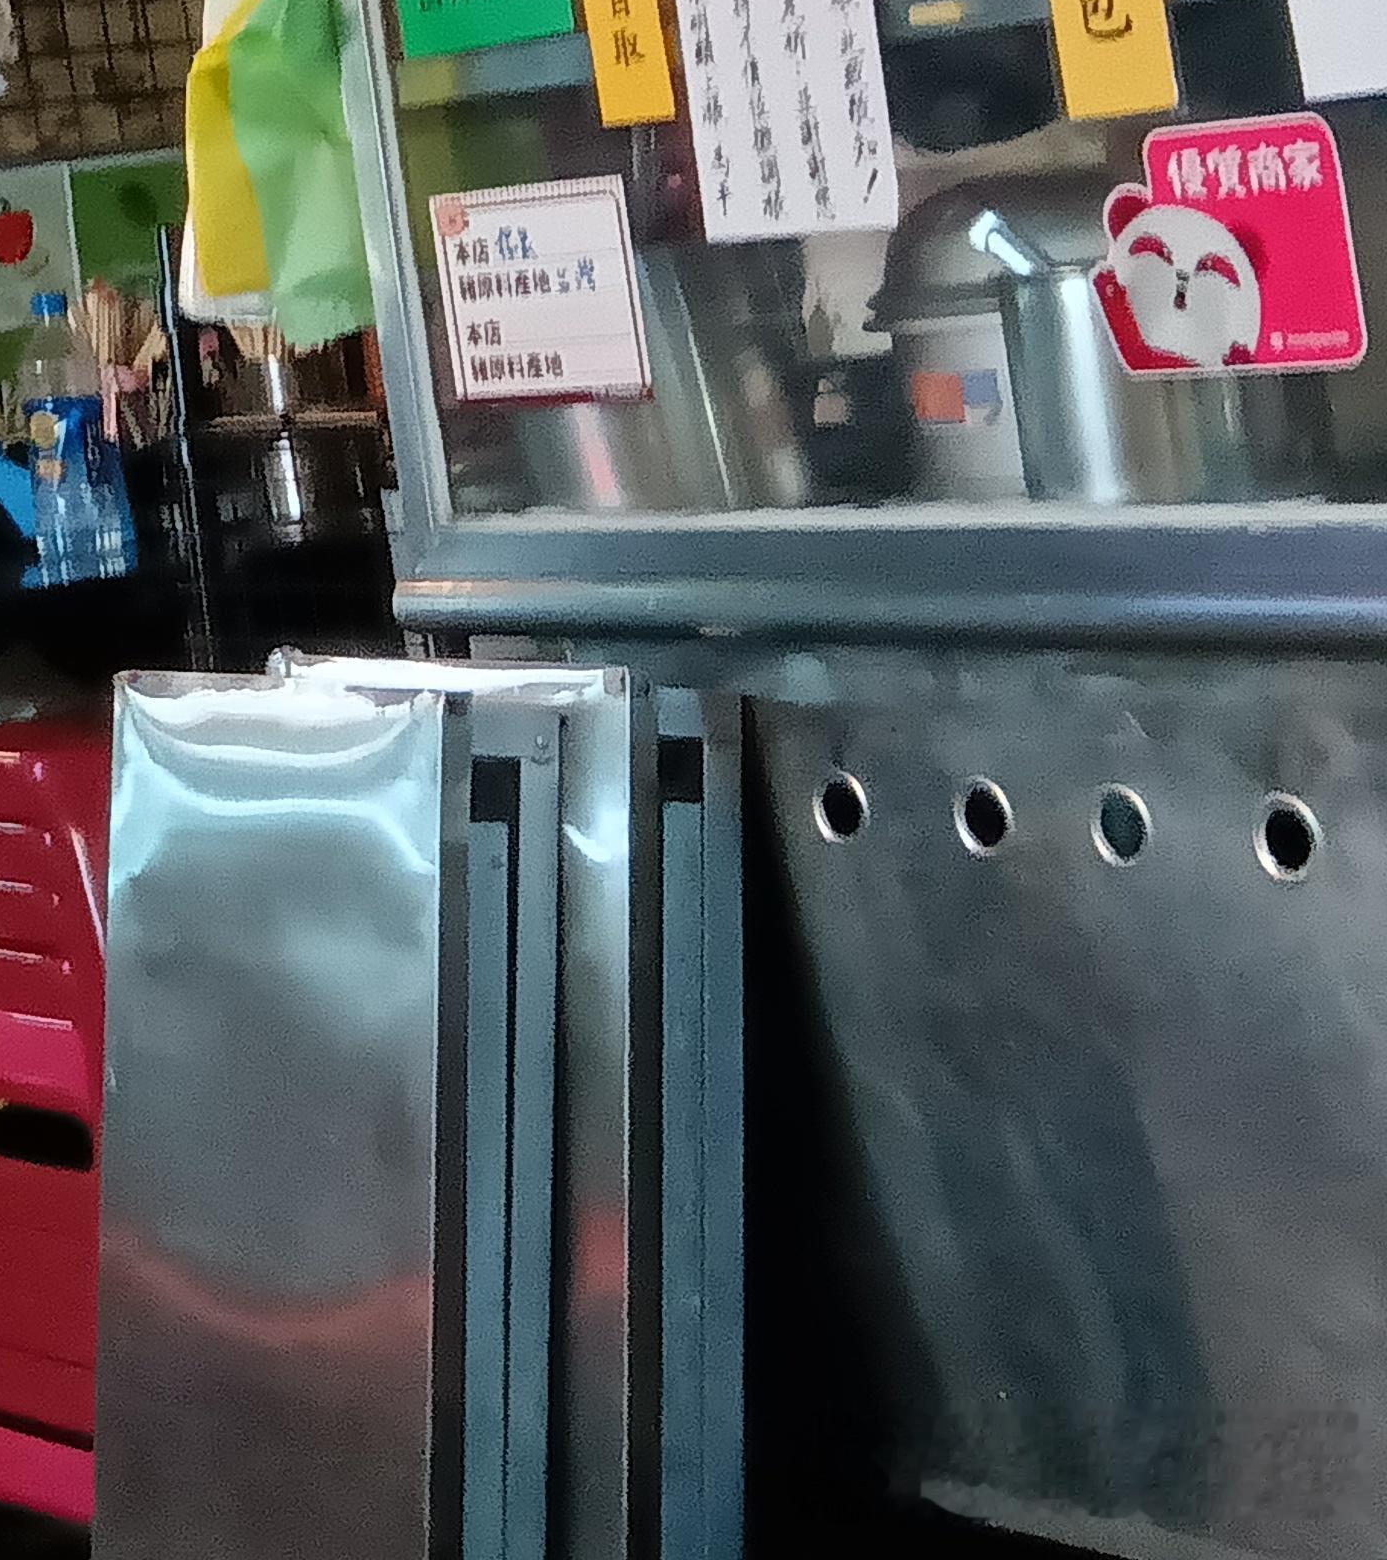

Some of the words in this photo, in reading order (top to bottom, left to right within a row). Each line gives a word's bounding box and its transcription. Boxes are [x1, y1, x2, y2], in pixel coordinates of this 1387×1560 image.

[1167, 139, 1324, 200] 優質商家
[453, 236, 491, 267] 本店
[466, 318, 502, 348] 本店
